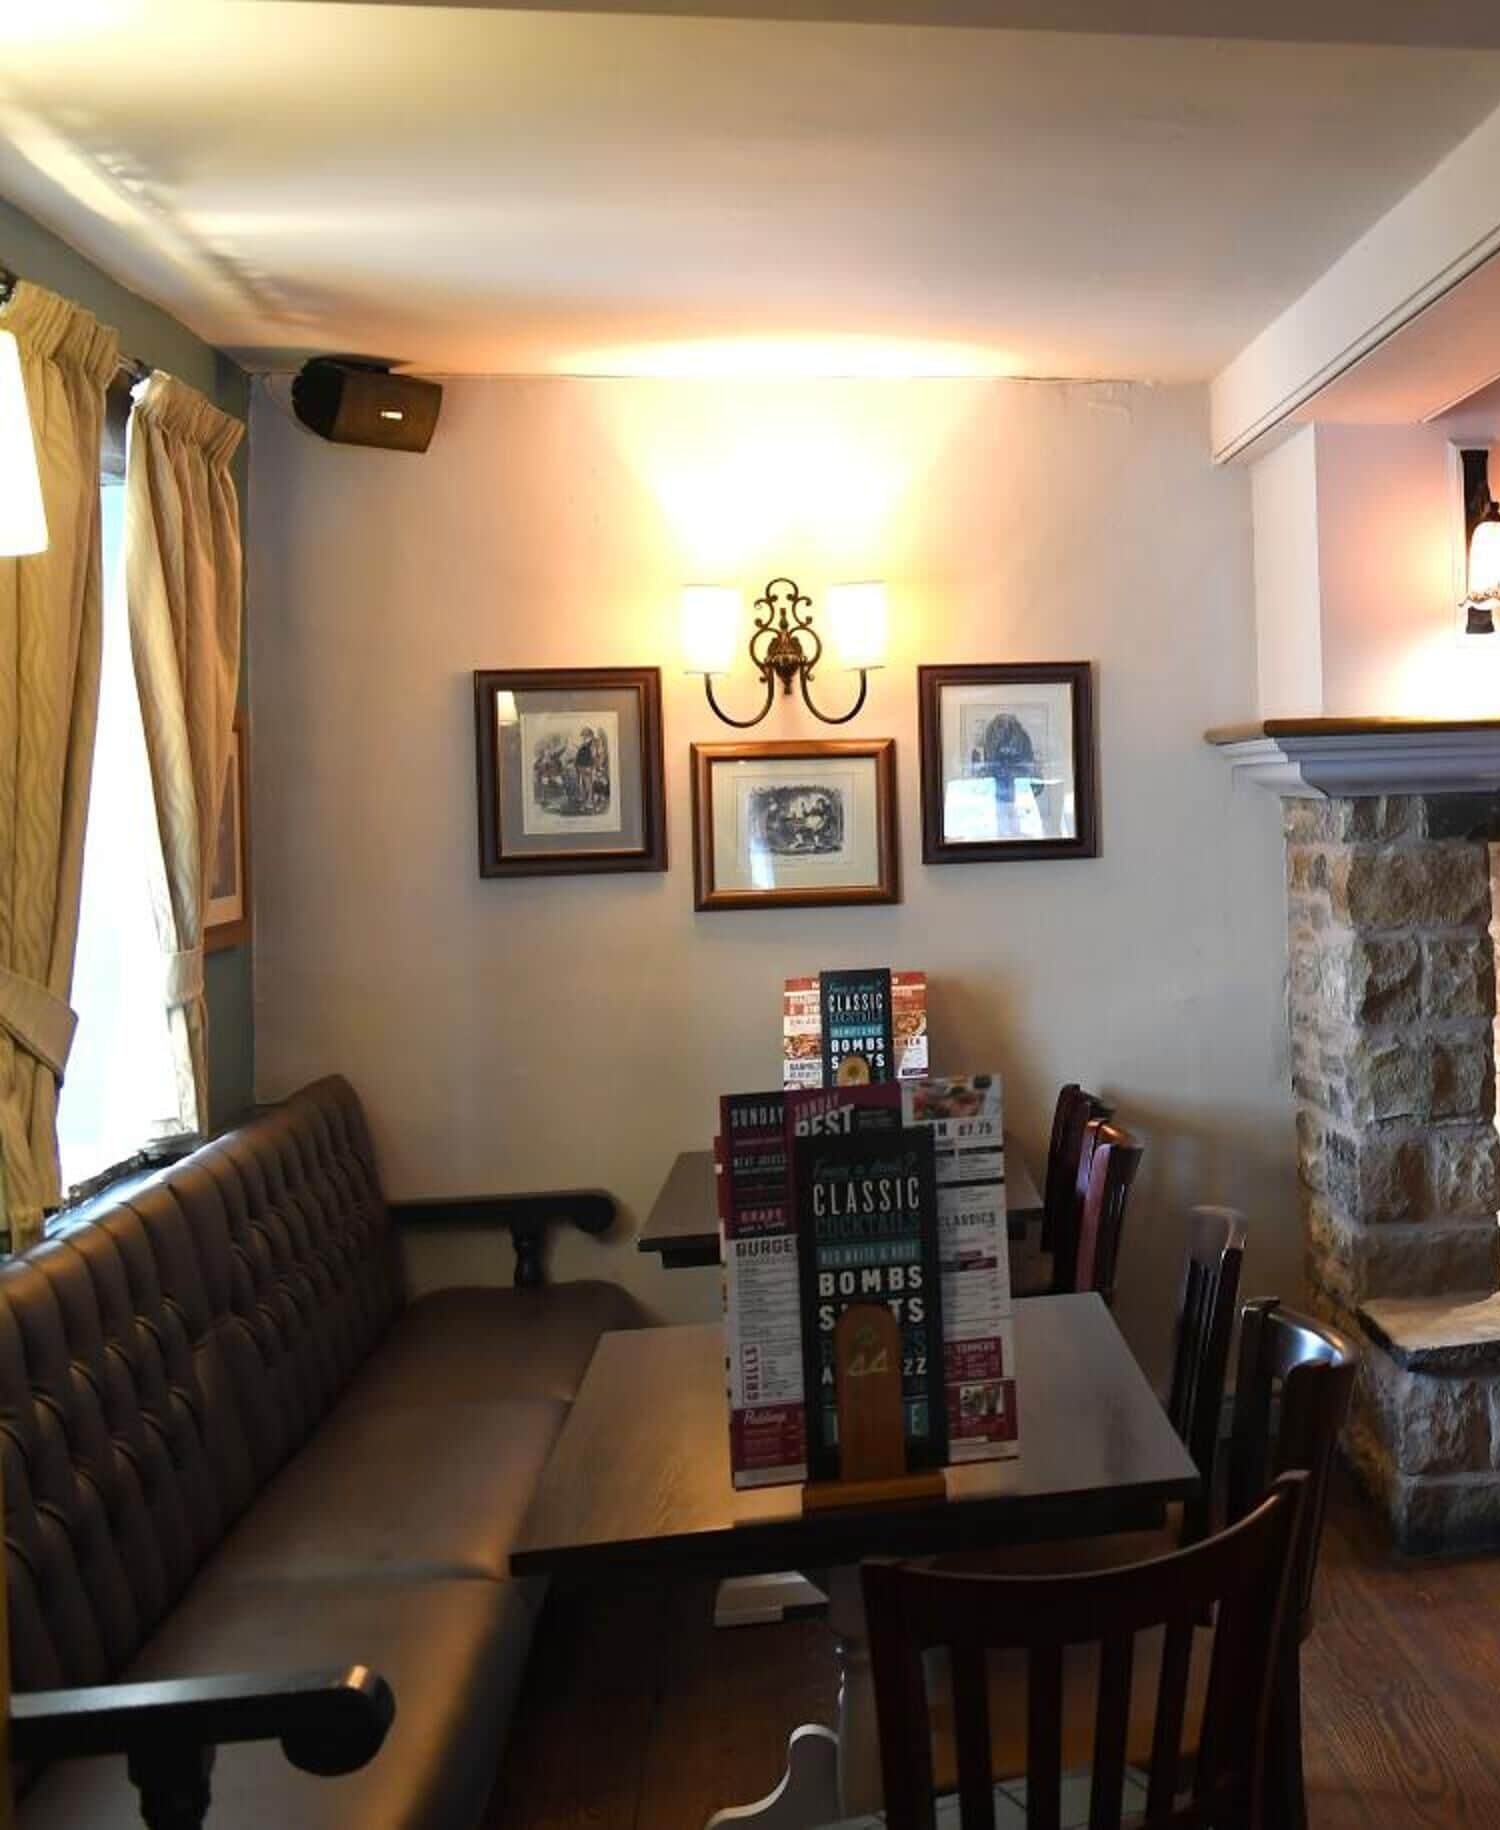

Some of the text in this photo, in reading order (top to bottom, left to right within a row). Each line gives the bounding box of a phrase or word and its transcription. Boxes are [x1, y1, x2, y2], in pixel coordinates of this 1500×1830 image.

[828, 993, 883, 1012] CLASSIC
[831, 1037, 885, 1053] BOMBS
[832, 1053, 885, 1070] STS
[731, 1104, 785, 1129] SUNDAY
[794, 1103, 855, 1137] BEST
[813, 1177, 919, 1216] CLASSIC
[818, 1265, 923, 1296] BOMBS
[818, 1297, 925, 1331] STS
[745, 1347, 759, 1401] GRILLS
